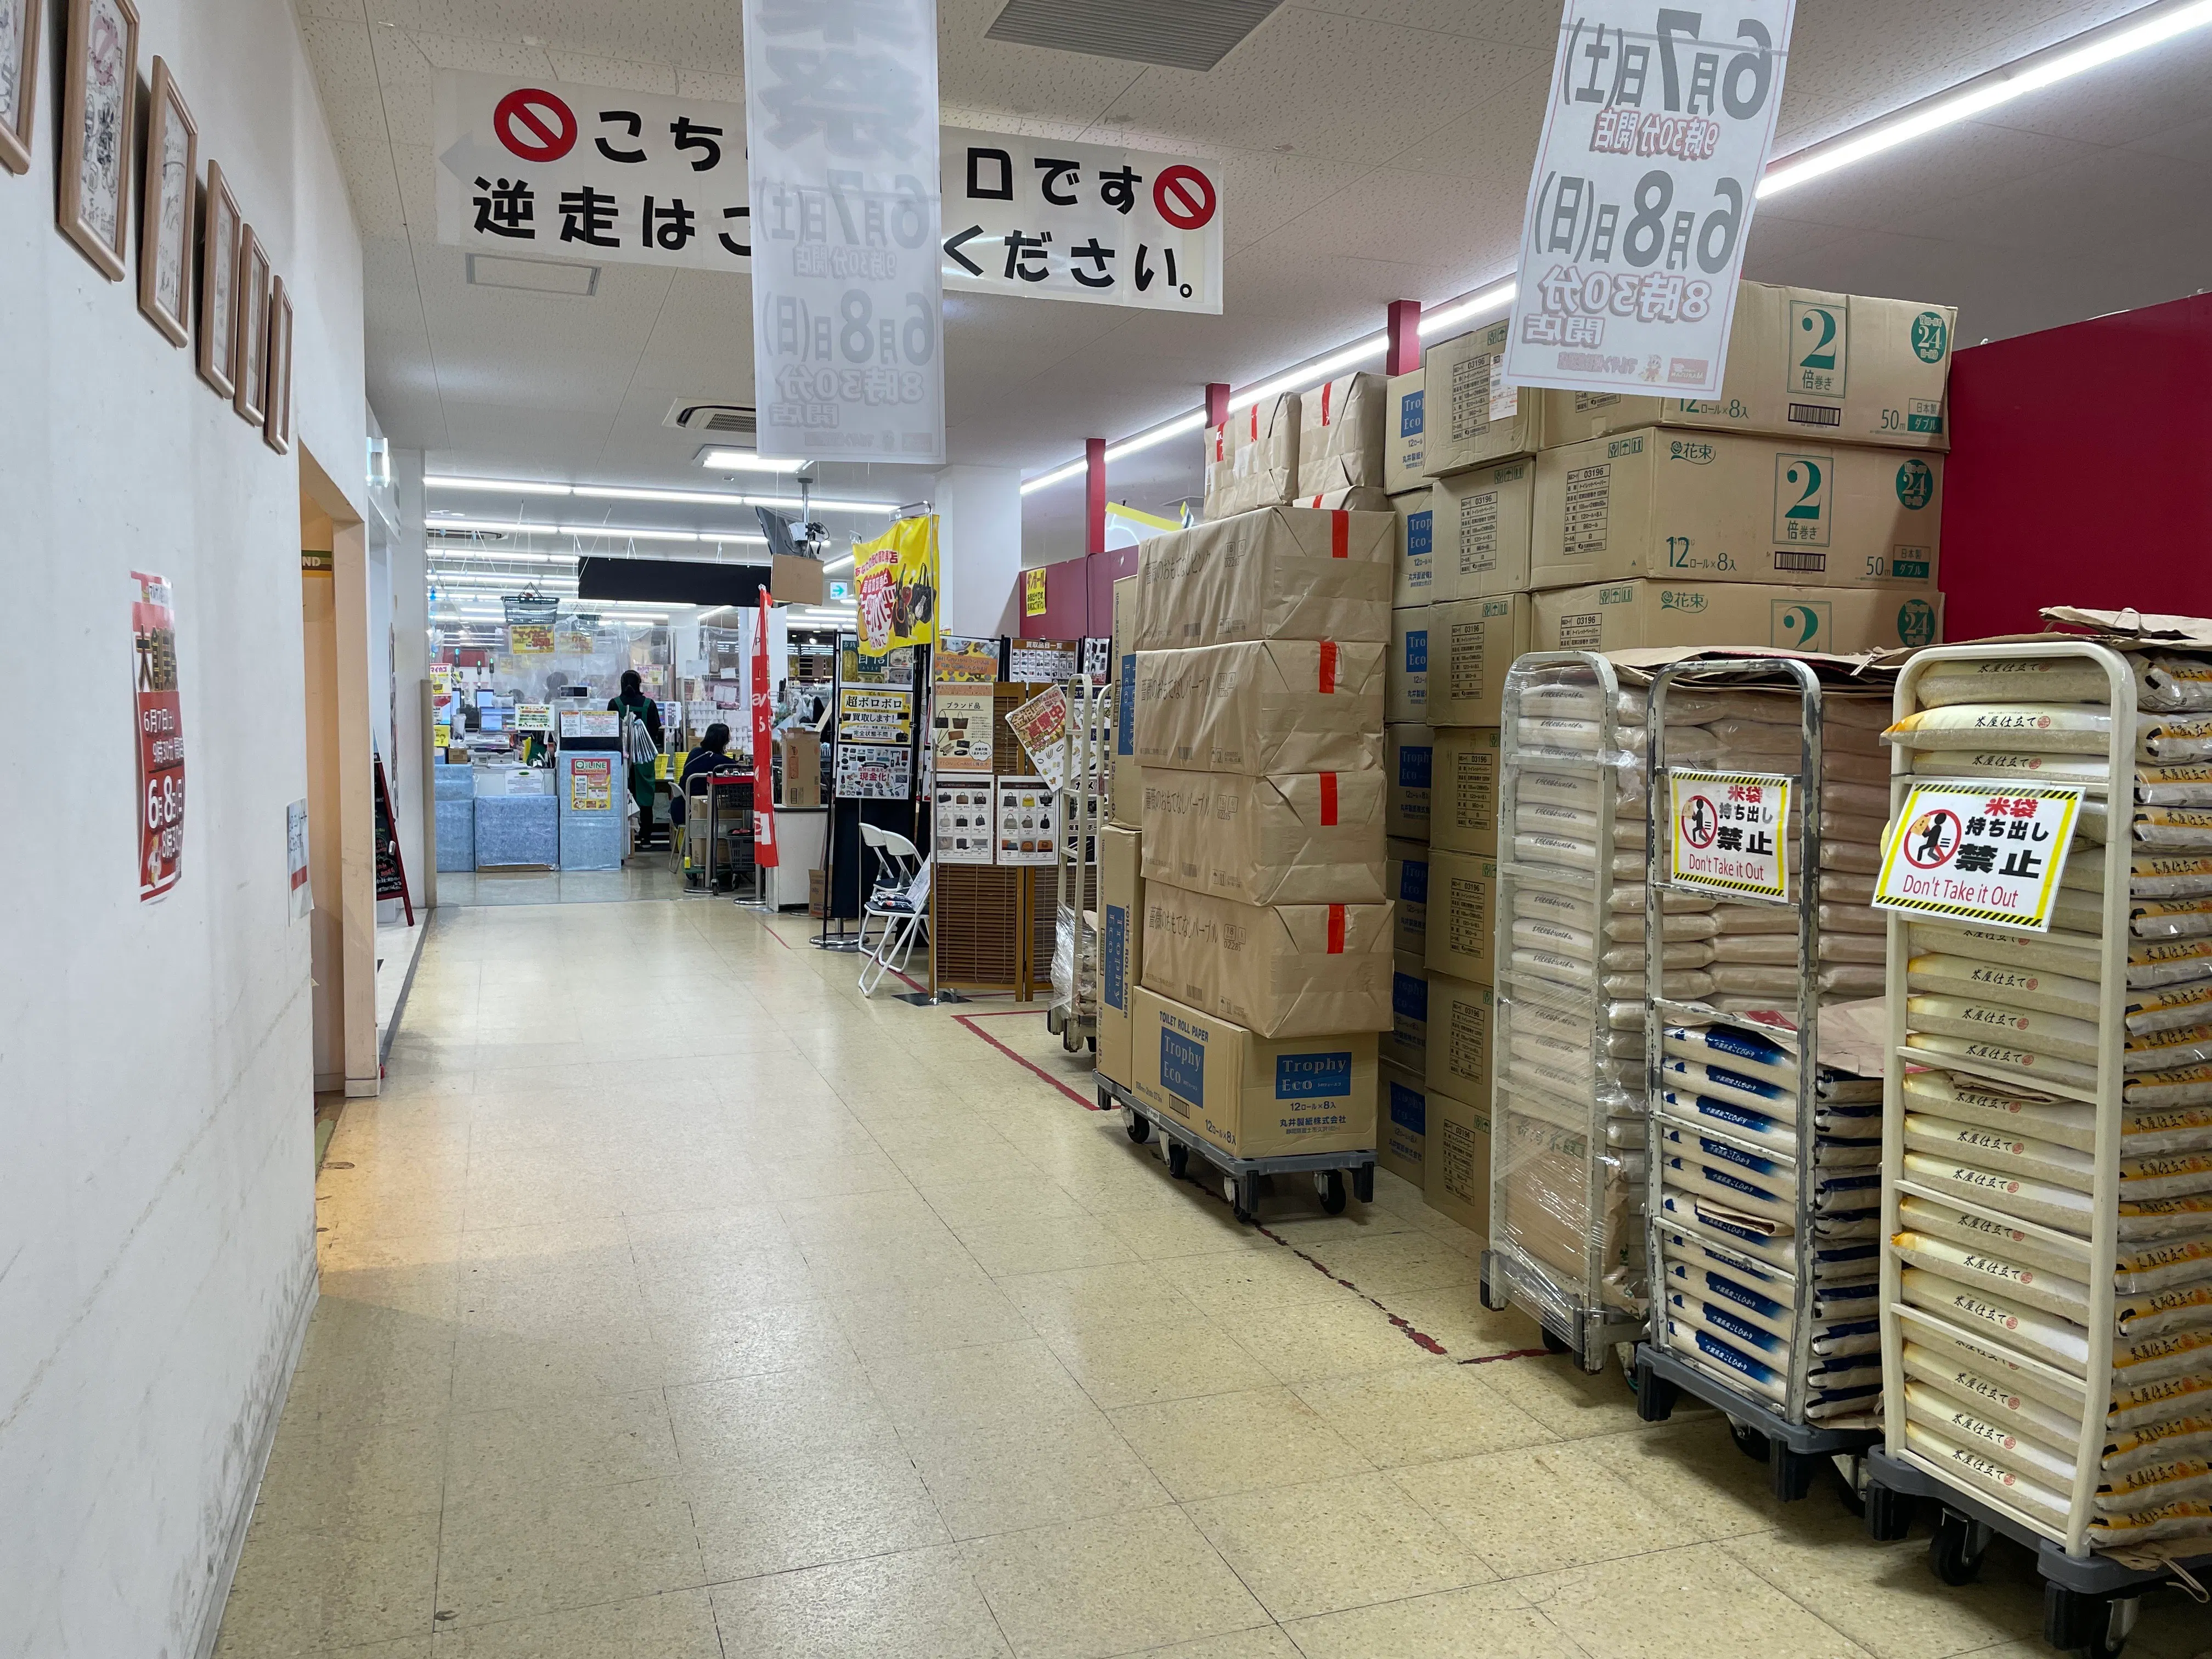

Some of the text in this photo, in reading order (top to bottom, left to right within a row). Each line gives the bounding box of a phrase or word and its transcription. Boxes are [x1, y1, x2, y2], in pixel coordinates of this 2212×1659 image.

[1799, 309, 1837, 370] 2
[1918, 325, 1941, 349] 24
[1467, 357, 1485, 370] 03196
[1802, 370, 1832, 391] 倍巻き
[1679, 398, 1749, 419] 12ロール×8入
[1916, 402, 1937, 415] 日本製
[1404, 416, 1421, 431] Eco
[1881, 409, 1906, 431] 50m
[1915, 417, 1937, 431] ダブル
[1683, 443, 1713, 460] 花束
[1584, 467, 1604, 479] 03196
[1579, 481, 1607, 489] トイレットペーパー
[1785, 460, 1822, 520] 2
[1901, 473, 1927, 495] 24
[1475, 495, 1492, 505] 03196
[1787, 520, 1818, 540] 倍巻き
[1410, 535, 1426, 549] Eco
[1666, 537, 1737, 572] 12ロール×8入
[1900, 548, 1922, 560] 日本製
[1866, 556, 1891, 577] 50m
[1899, 565, 1922, 575] ダブル
[1674, 592, 1705, 608] 花束
[1464, 625, 1480, 633] 03196
[1576, 615, 1596, 625] 03196
[1784, 606, 1819, 652] 2
[1904, 613, 1929, 634] 24
[1026, 641, 1063, 650] 買取品目一覧
[1408, 653, 1426, 666] Eco
[1978, 661, 2039, 673] 米屋仕立て
[846, 696, 902, 708] 超ボロボロ
[1975, 715, 2036, 728] 米屋仕立て
[1971, 755, 2029, 768] 米屋仕立て
[1402, 767, 1417, 781] Eco
[1728, 785, 1764, 804] 米袋
[1719, 803, 1773, 823] 持ち出し
[1983, 796, 2038, 819] 米袋
[1964, 816, 2049, 842] 持ち出し
[1717, 826, 1773, 857] 禁止
[1689, 853, 1764, 882] Don't Take it Out
[1953, 843, 2043, 880] 禁止
[1464, 883, 1480, 892] 03196
[1903, 873, 2019, 908] Don't Take it Out
[1226, 926, 1234, 935] 18
[1223, 940, 1241, 951] 02285
[1114, 916, 1123, 1002] Trophy
[1971, 969, 2027, 989] 米屋仕立て
[1464, 1007, 1480, 1018] 03196
[1962, 1008, 2017, 1026] 米屋仕立て
[1159, 1011, 1209, 1043] TOILET ROLL PAPER
[1164, 1035, 1201, 1072] Trophy
[1966, 1045, 2022, 1063] 米屋仕立て
[1164, 1060, 1181, 1085] Eco
[1283, 1057, 1346, 1074] Trophy
[1282, 1078, 1312, 1092] Eco
[1290, 1101, 1336, 1111] 12ロール×8入
[1954, 1092, 2010, 1110] 米屋仕立て
[1455, 1125, 1471, 1139] 03196
[1957, 1130, 2013, 1152] 米屋仕立て
[1952, 1169, 2008, 1190] 米屋仕立て
[1957, 1215, 2013, 1238] 米屋仕立て
[1963, 1255, 2021, 1281] 米屋仕立て
[1954, 1295, 2007, 1325] 米屋仕立て
[1954, 1372, 2009, 1405] 米屋仕立て
[1952, 1413, 2005, 1444] 米屋仕立て
[1952, 1449, 2005, 1480] 米屋仕立て
